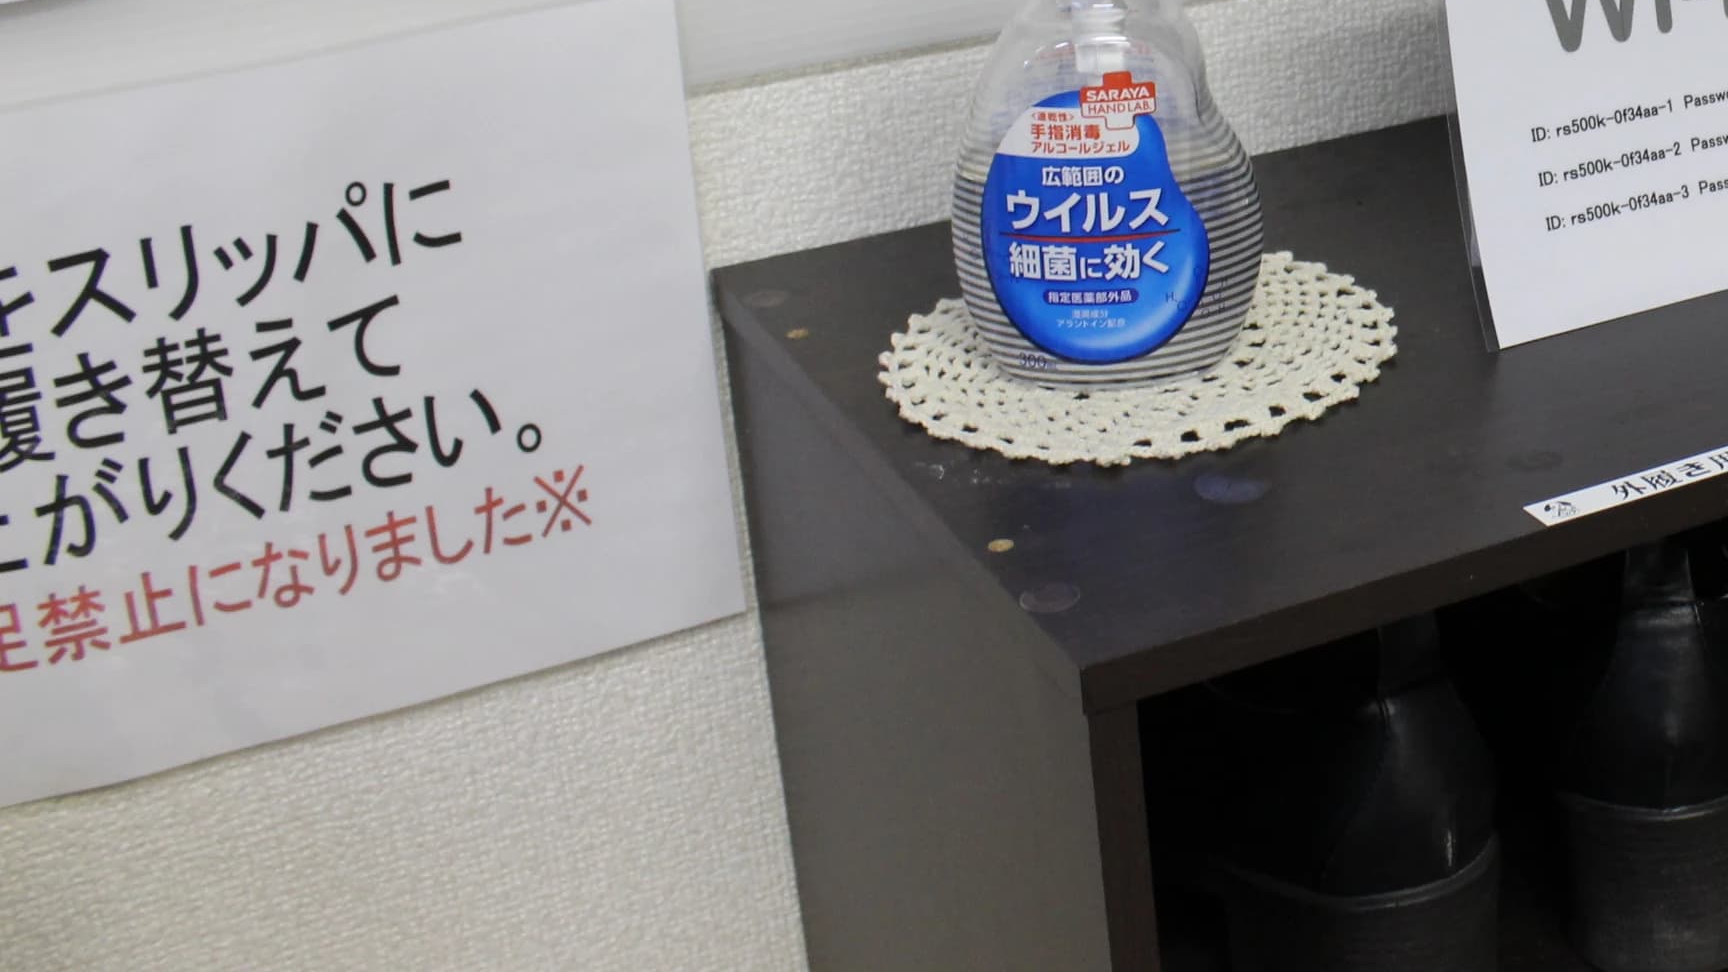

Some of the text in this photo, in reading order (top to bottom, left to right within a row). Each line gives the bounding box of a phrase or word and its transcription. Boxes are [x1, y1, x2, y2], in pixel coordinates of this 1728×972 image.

[1086, 85, 1151, 102] SARAYA
[1030, 124, 1101, 141] 手指消毒
[1531, 126, 1551, 143] ID:
[1556, 97, 1674, 138] rs500k-0f34aa-1
[1031, 141, 1131, 154] アルコールジェル
[1042, 165, 1125, 187] 広範囲の
[1538, 170, 1559, 187] ID:
[1563, 140, 1682, 182] rs500k-0f34aa-2
[1006, 187, 1169, 233] ウイルス
[1545, 215, 1566, 232] ID:
[1570, 183, 1690, 227] rs500k-0f34aa-3
[1008, 240, 1170, 281] 細菌に効く
[1048, 289, 1132, 305] 指定医薬部外品
